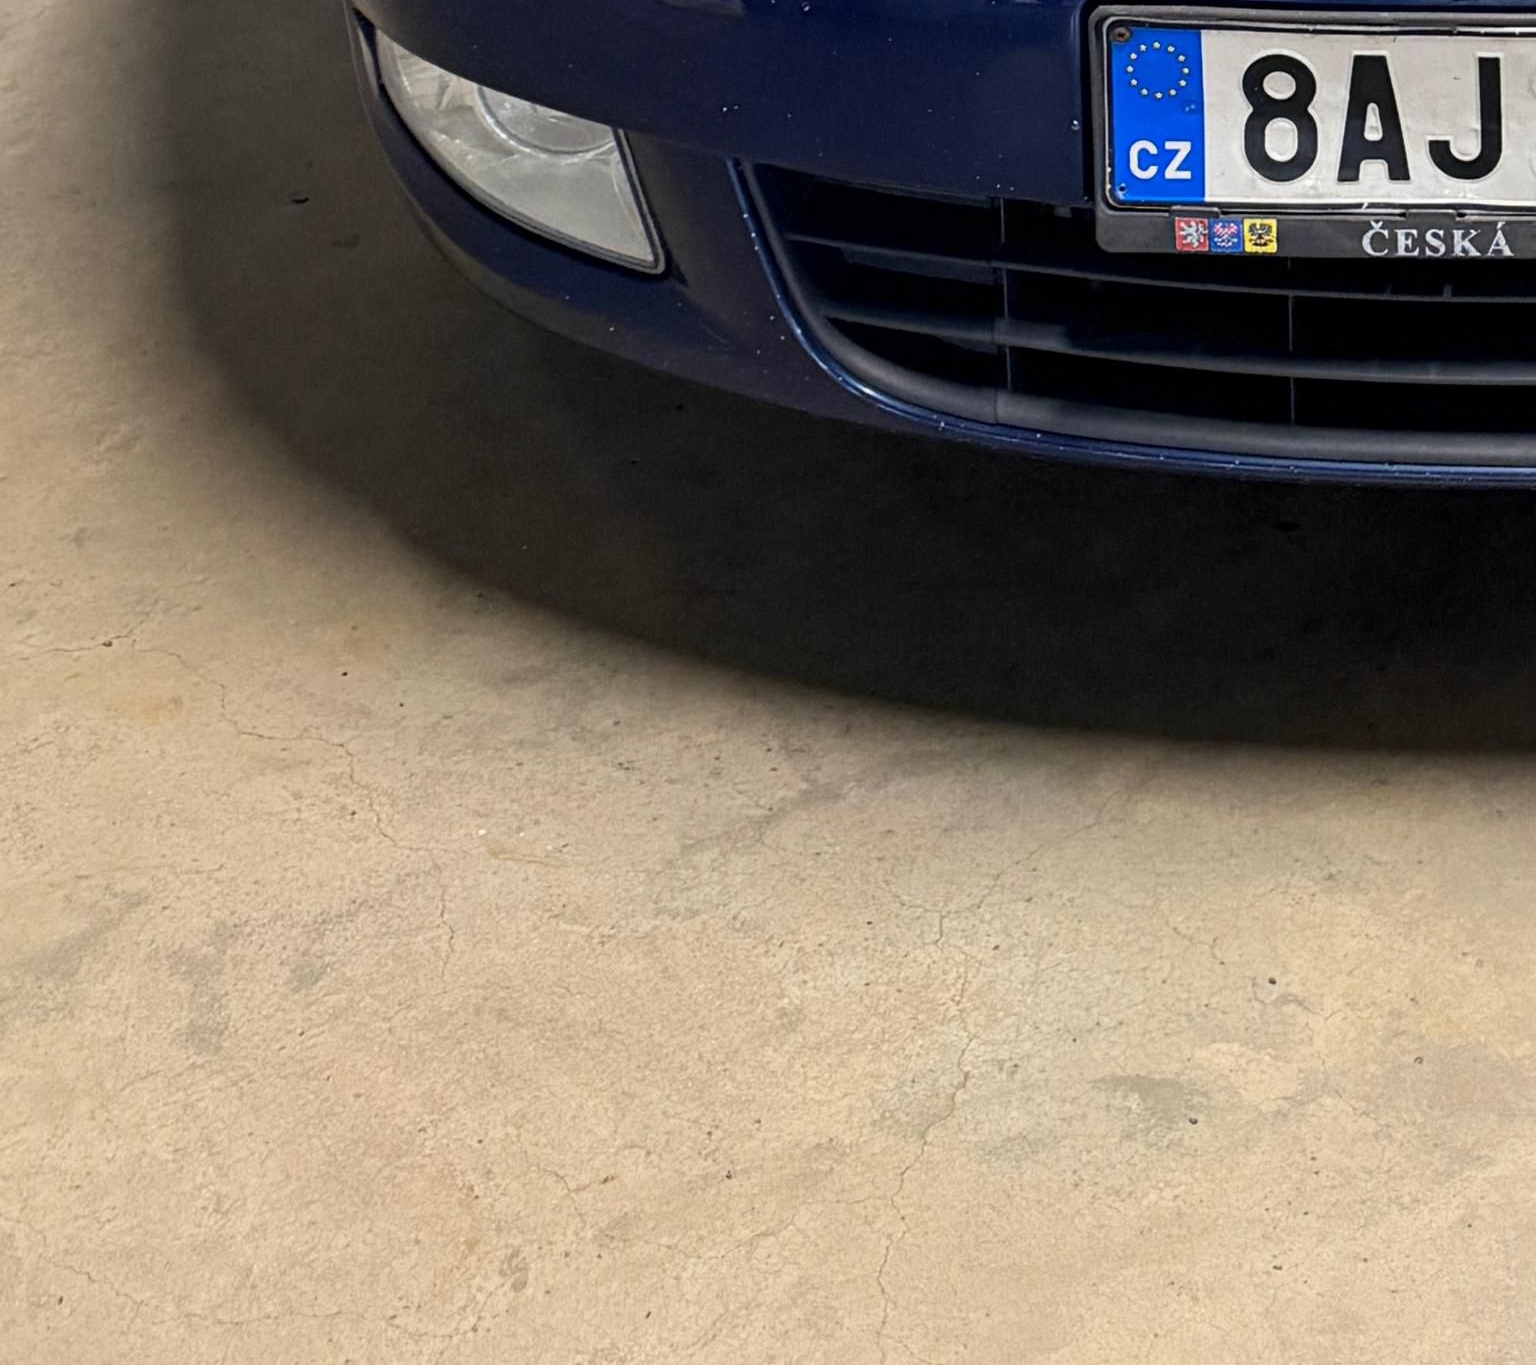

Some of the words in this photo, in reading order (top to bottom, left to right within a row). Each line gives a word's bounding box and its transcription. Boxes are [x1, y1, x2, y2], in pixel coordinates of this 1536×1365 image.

[1241, 49, 1503, 183] 8AJ
[1128, 139, 1192, 180] CZ
[1361, 221, 1514, 258] ČESKÁ
